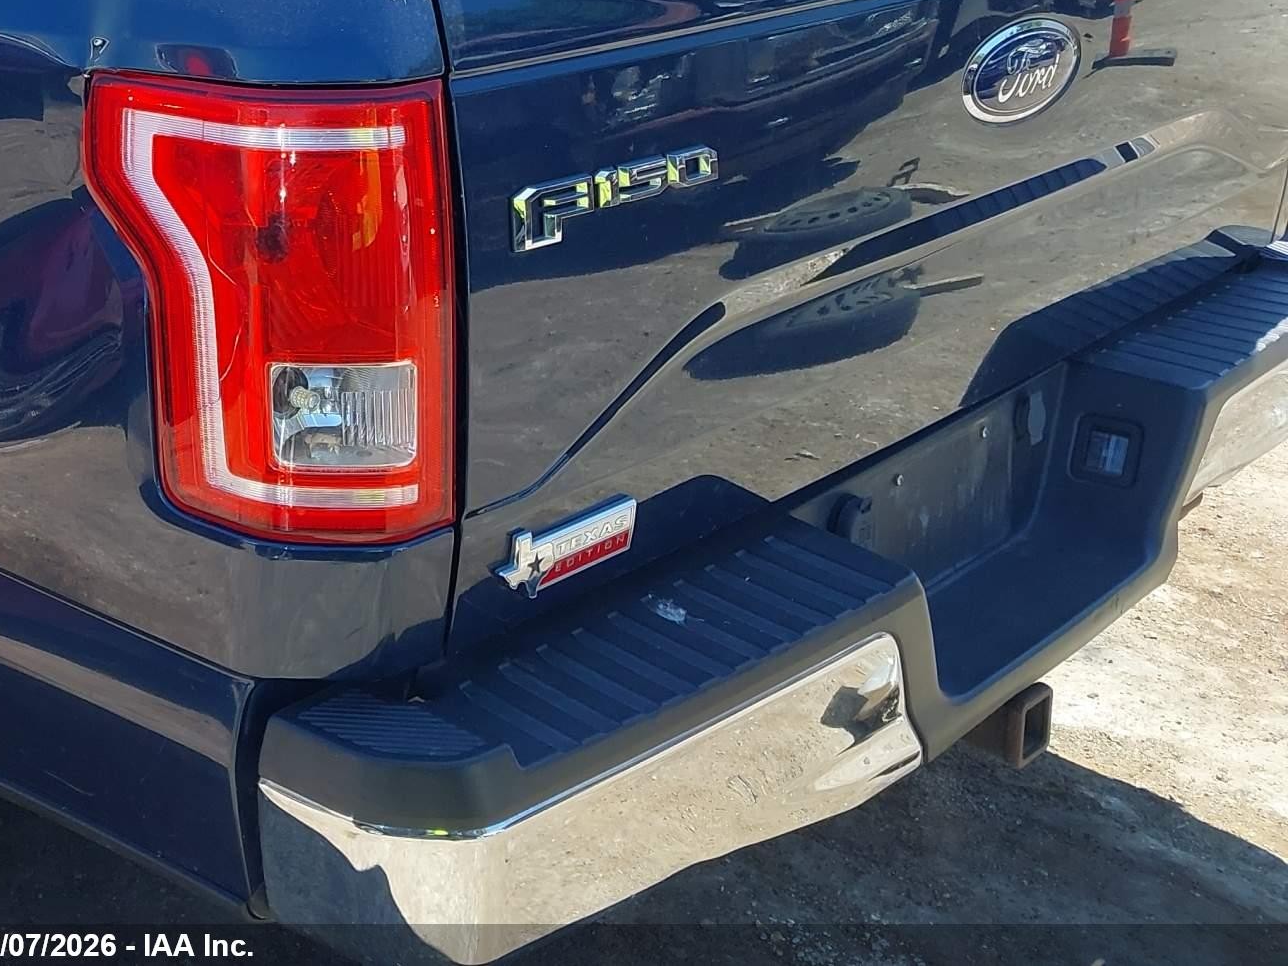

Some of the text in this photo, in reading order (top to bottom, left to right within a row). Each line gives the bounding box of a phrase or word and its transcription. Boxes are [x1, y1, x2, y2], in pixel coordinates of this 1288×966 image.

[997, 37, 1062, 104] Ford
[554, 534, 626, 573] EDITION
[555, 514, 628, 556] TEXAS
